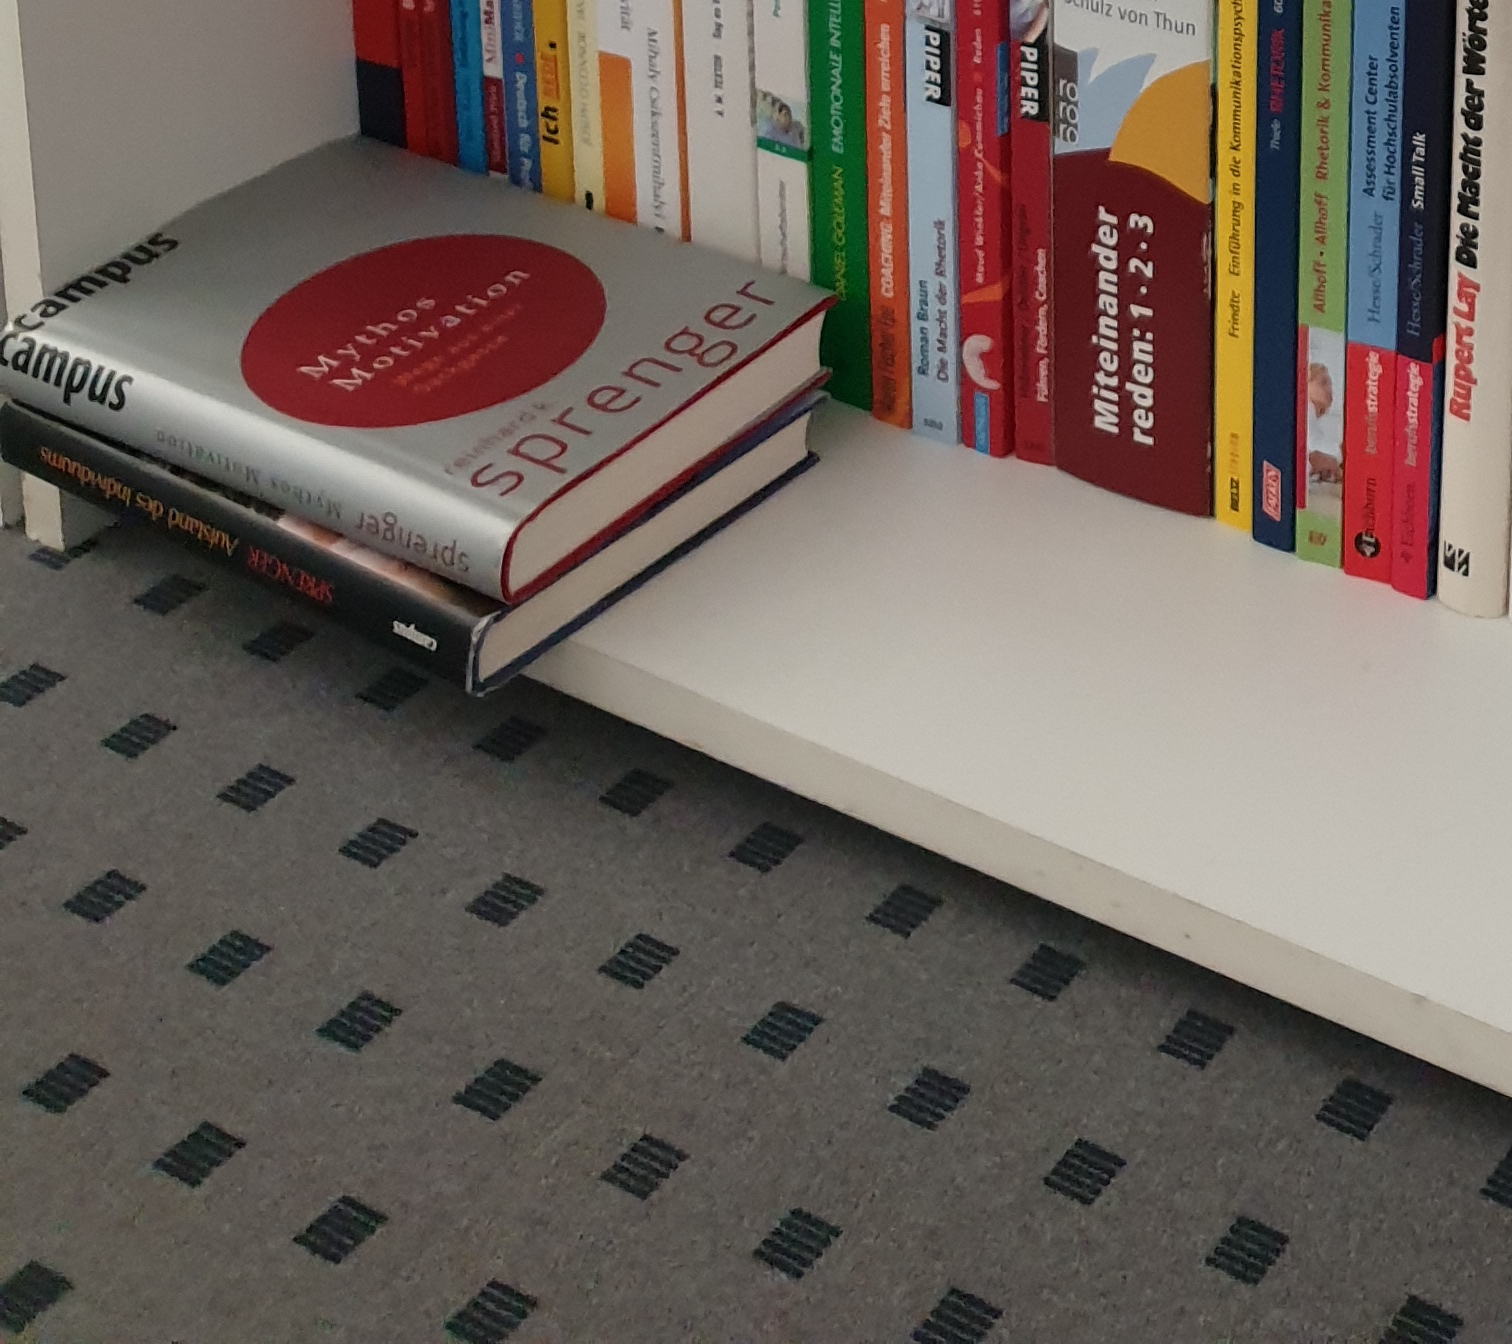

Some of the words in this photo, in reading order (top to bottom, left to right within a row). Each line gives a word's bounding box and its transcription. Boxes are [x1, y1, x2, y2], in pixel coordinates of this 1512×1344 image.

[925, 25, 943, 99] PIPER
[1458, 81, 1484, 131] der
[1229, 158, 1242, 178] die
[1411, 133, 1426, 163] Talk
[1455, 136, 1482, 217] Macht
[1128, 213, 1153, 234] 3
[1228, 183, 1242, 196] in
[1410, 168, 1426, 209] Small
[1228, 202, 1244, 277] Einführung
[1453, 222, 1478, 268] Die
[14, 232, 181, 331] campus
[1128, 305, 1154, 319] 1
[1453, 274, 1479, 320] Lay
[297, 296, 437, 382] Mythos
[333, 268, 531, 392] Motivation
[1091, 207, 1120, 433] Miteinander
[470, 280, 779, 496] sprenger
[1128, 332, 1156, 445] reden:
[1448, 325, 1477, 422] Rupert
